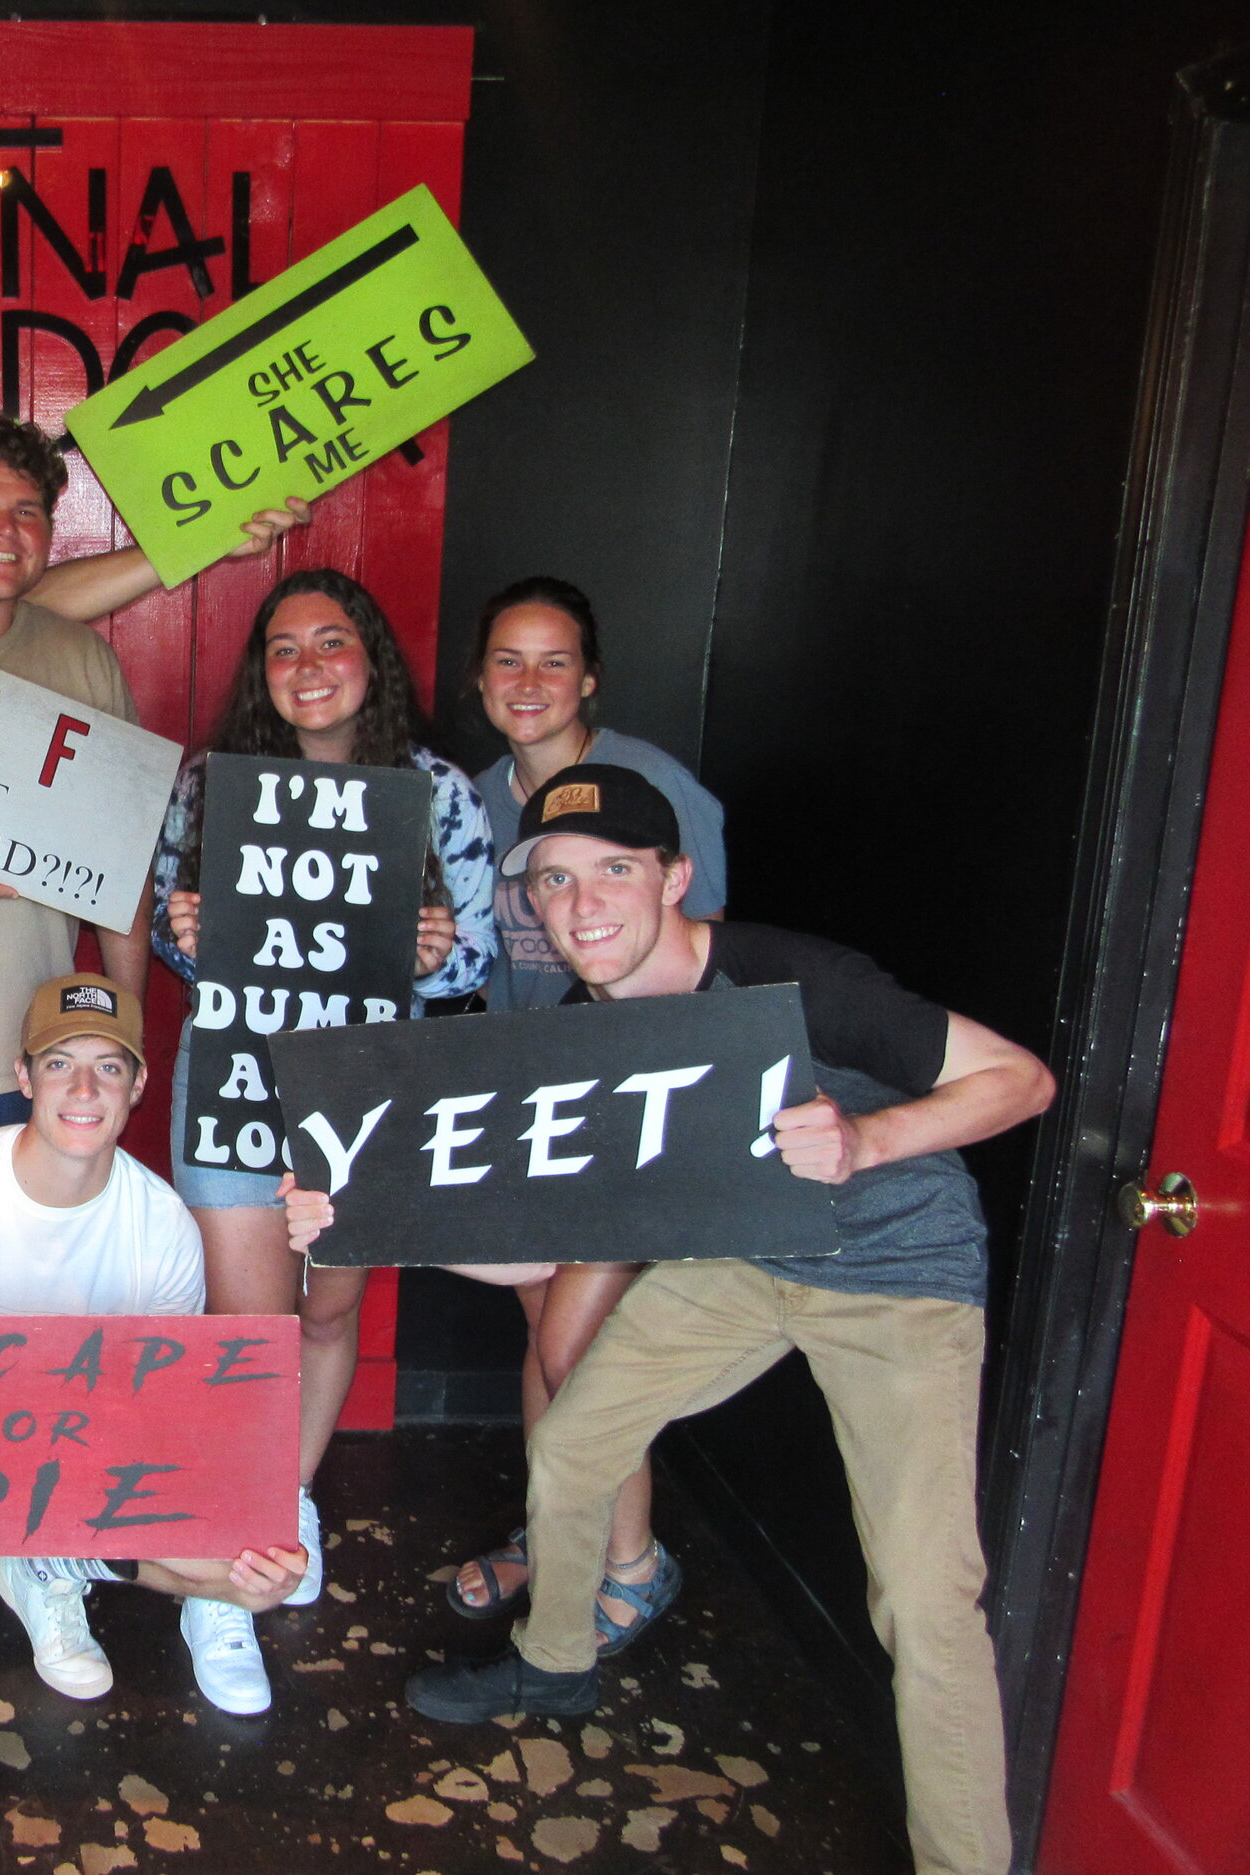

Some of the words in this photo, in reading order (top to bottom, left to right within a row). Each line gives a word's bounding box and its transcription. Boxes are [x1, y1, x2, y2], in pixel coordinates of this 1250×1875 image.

[248, 340, 326, 407] SHE
[161, 304, 472, 528] SCARES
[303, 431, 370, 484] ME
[253, 773, 368, 832] I'M
[235, 844, 379, 905] NOT
[252, 918, 347, 972] AS
[66, 992, 96, 1001] NORTH
[74, 997, 96, 1005] FACE
[192, 981, 398, 1035] DUMB
[218, 1052, 280, 1102] A
[194, 1116, 293, 1170] LO
[2, 1410, 90, 1446] OR
